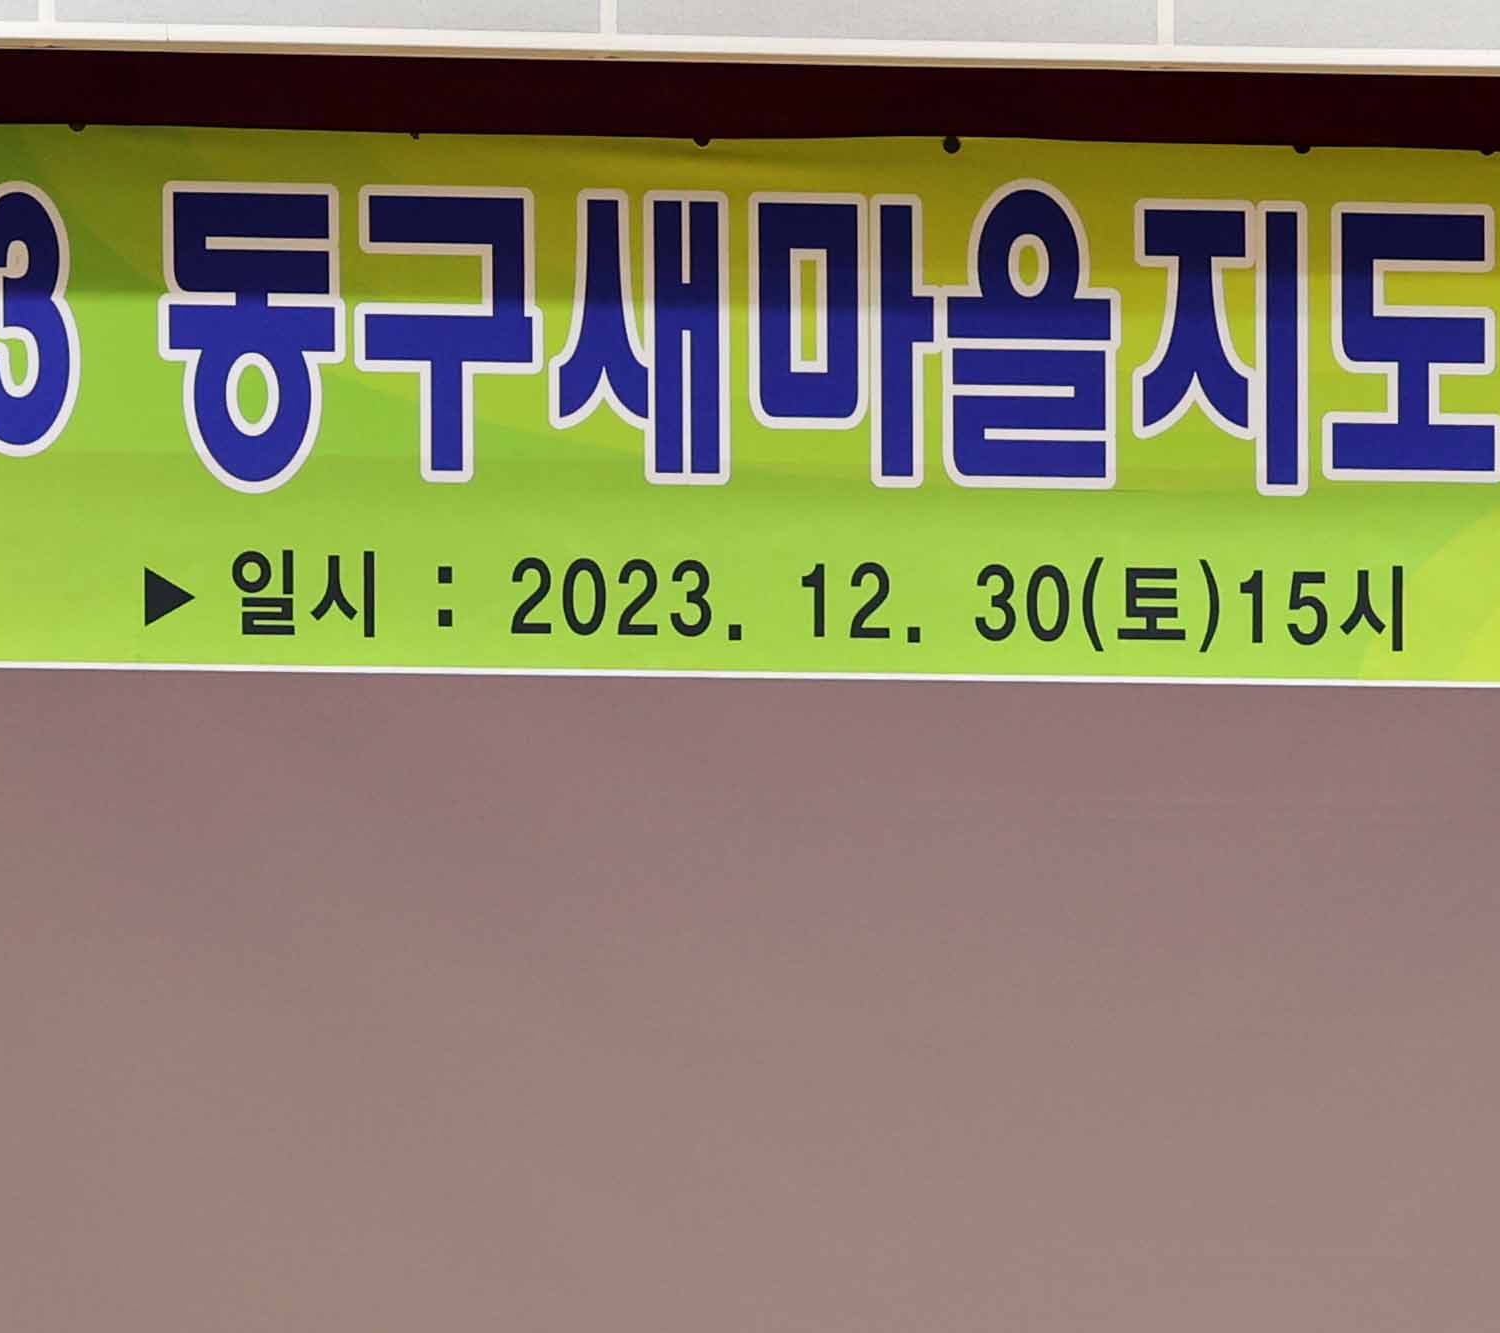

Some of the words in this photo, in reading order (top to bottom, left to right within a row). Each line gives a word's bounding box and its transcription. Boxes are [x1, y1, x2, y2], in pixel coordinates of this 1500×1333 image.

[231, 548, 377, 639] 일시
[437, 565, 454, 628] :
[510, 556, 743, 642] 2023.
[800, 561, 922, 644] 12.
[974, 556, 1405, 654] 30(토)15시
